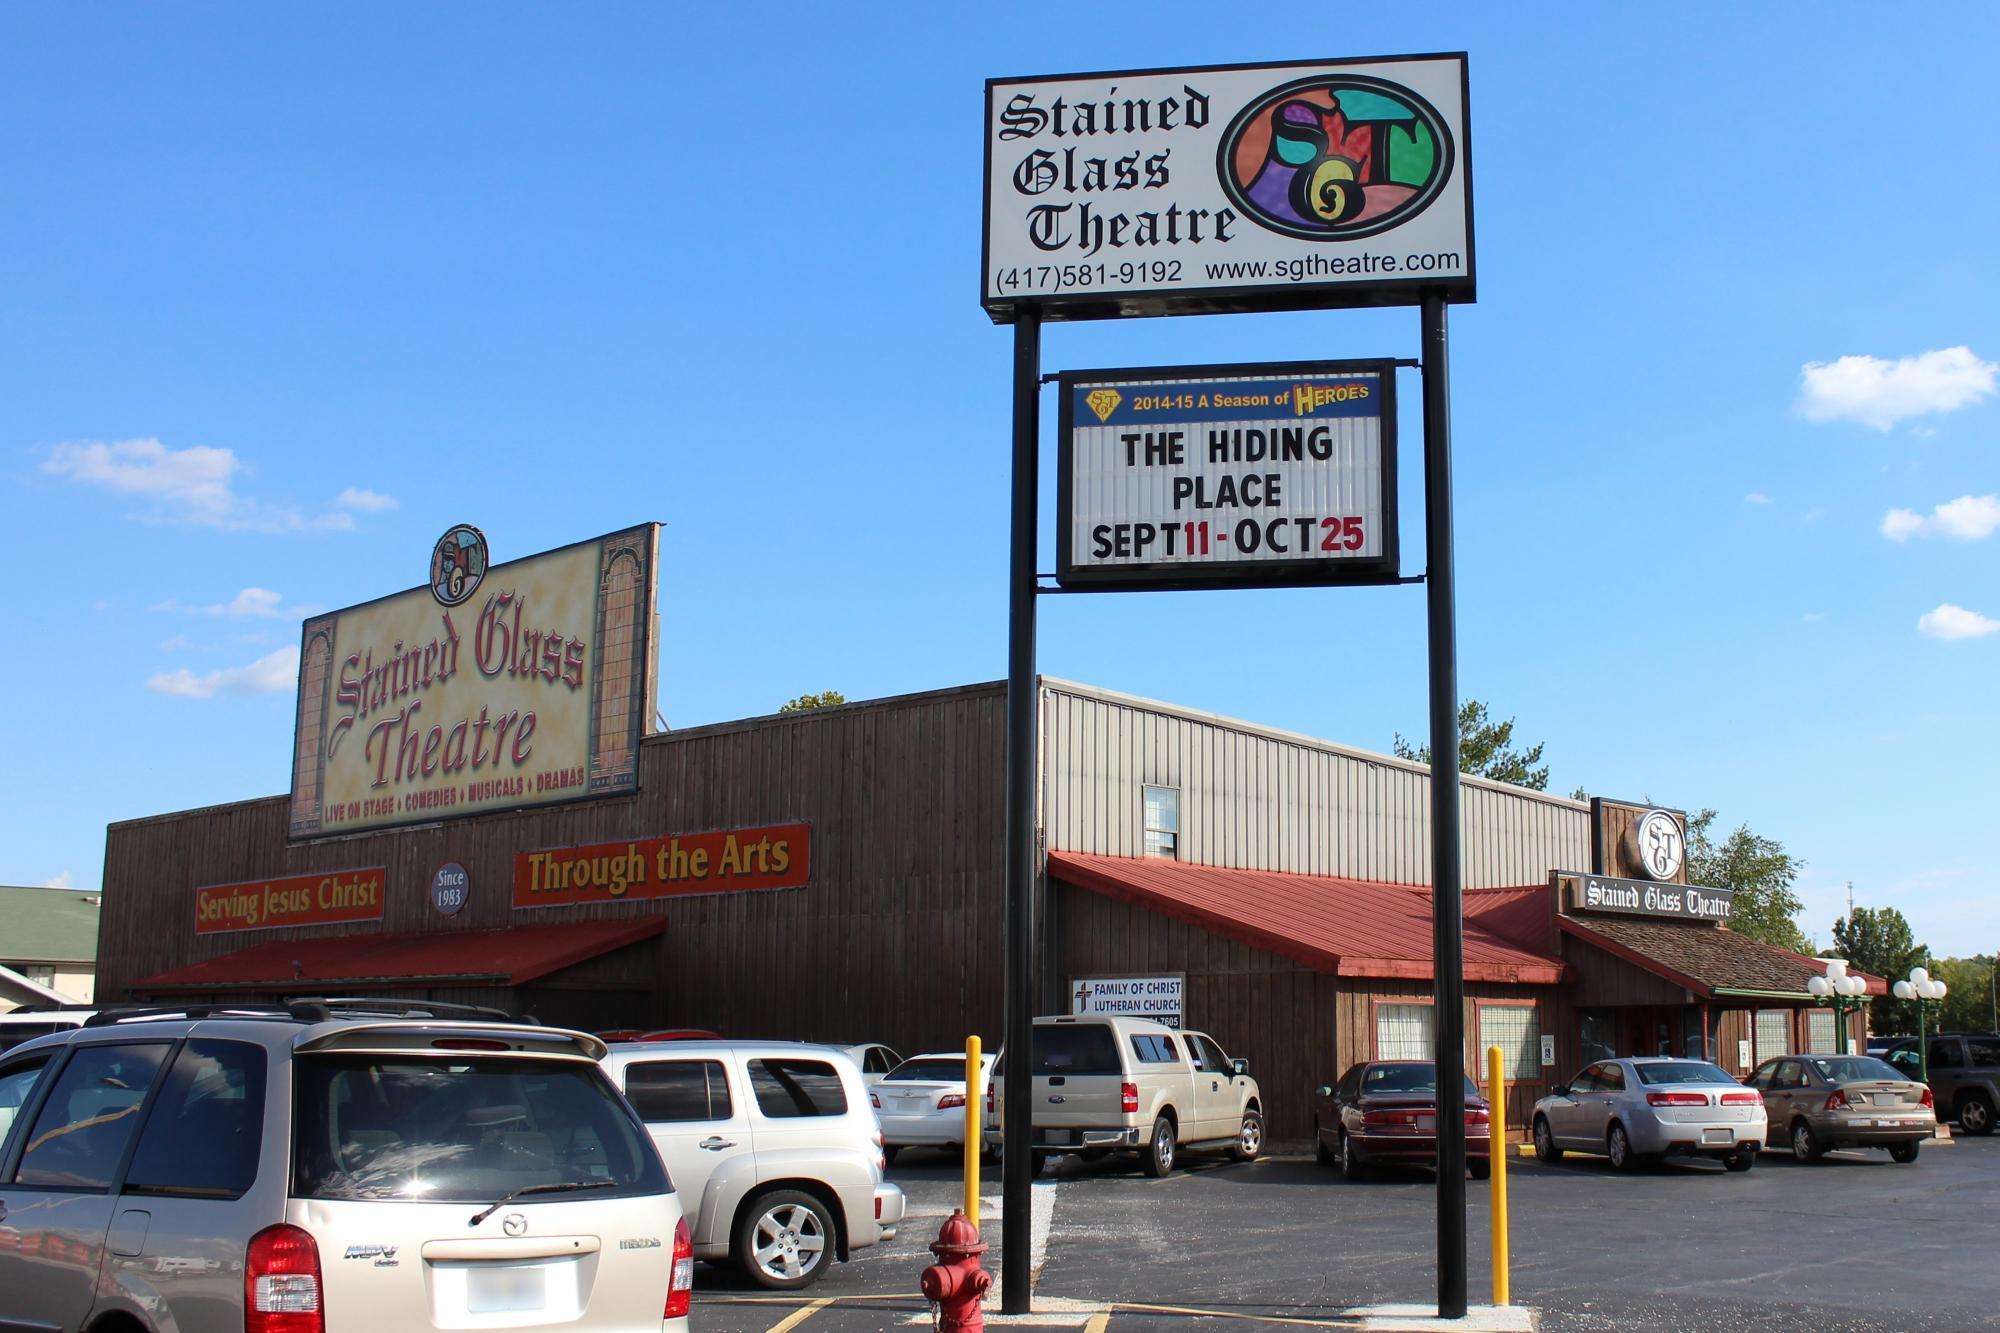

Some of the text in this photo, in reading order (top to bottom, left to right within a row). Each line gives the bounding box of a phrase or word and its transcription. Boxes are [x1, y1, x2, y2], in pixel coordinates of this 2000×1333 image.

[998, 84, 1211, 142] Stained
[1012, 147, 1172, 196] Glass
[1026, 201, 1238, 259] Theatre
[996, 249, 1461, 295] (417)581-9192 www.sgtheatre.com
[1133, 384, 1369, 416] 2014-15 A Season of HEROES
[1121, 425, 1333, 467] THE HIDING
[1173, 473, 1281, 510] PLACE
[328, 588, 587, 759] Stained Glass
[365, 698, 537, 789] Theatre
[324, 767, 586, 823] LIVE ON STAGE COMEDIES MUSICALS DRAMAS
[437, 870, 464, 887] Since
[528, 834, 790, 895] Through the Arts
[199, 875, 378, 924] Serving Jesus Christ
[438, 889, 461, 906] 1983
[1587, 879, 1731, 918] Stained Glass Theatre
[1094, 981, 1181, 996] FAMILY OF CHRIST
[1094, 998, 1181, 1012] LUTHERAN CHURCH
